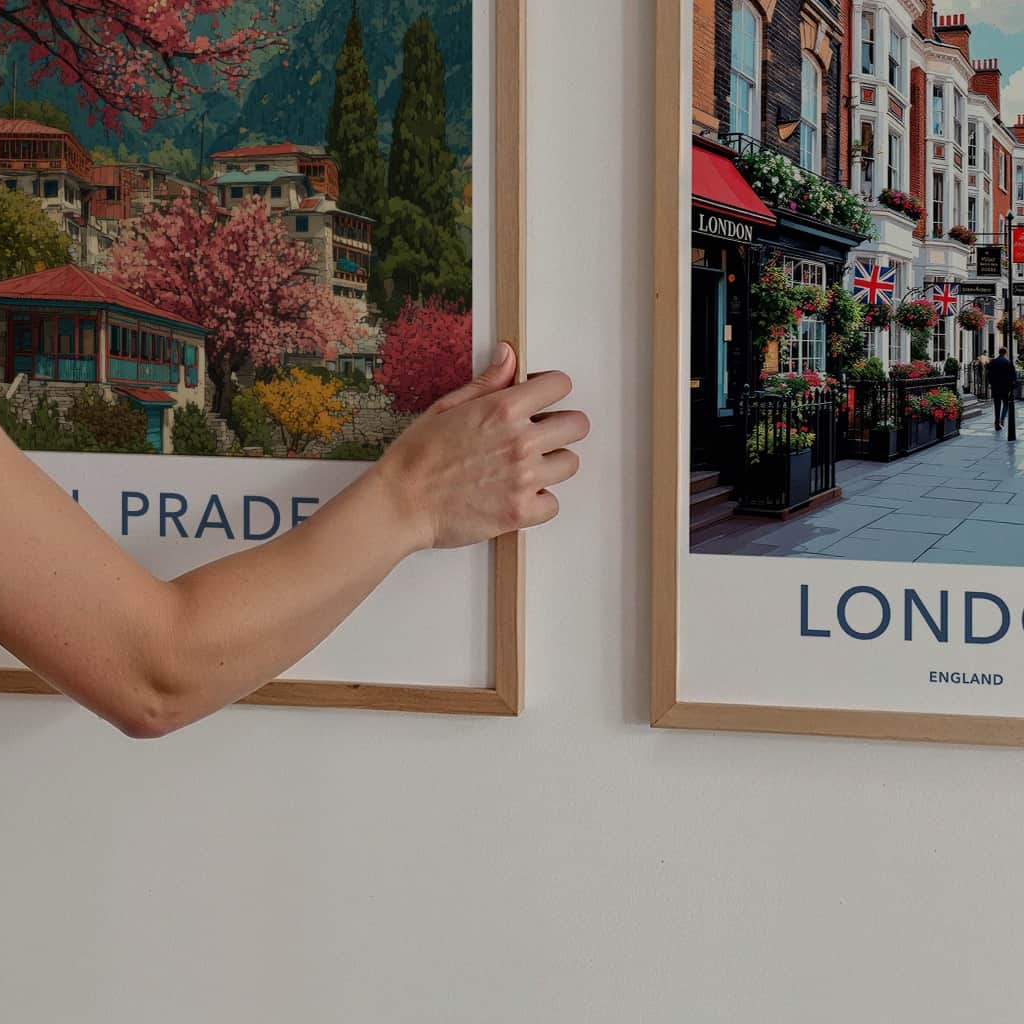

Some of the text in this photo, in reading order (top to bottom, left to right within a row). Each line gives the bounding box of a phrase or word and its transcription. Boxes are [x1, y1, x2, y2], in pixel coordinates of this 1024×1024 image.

[698, 213, 753, 242] LONDON
[800, 584, 1024, 645] LOND
[929, 671, 1004, 686] ENGLAND
